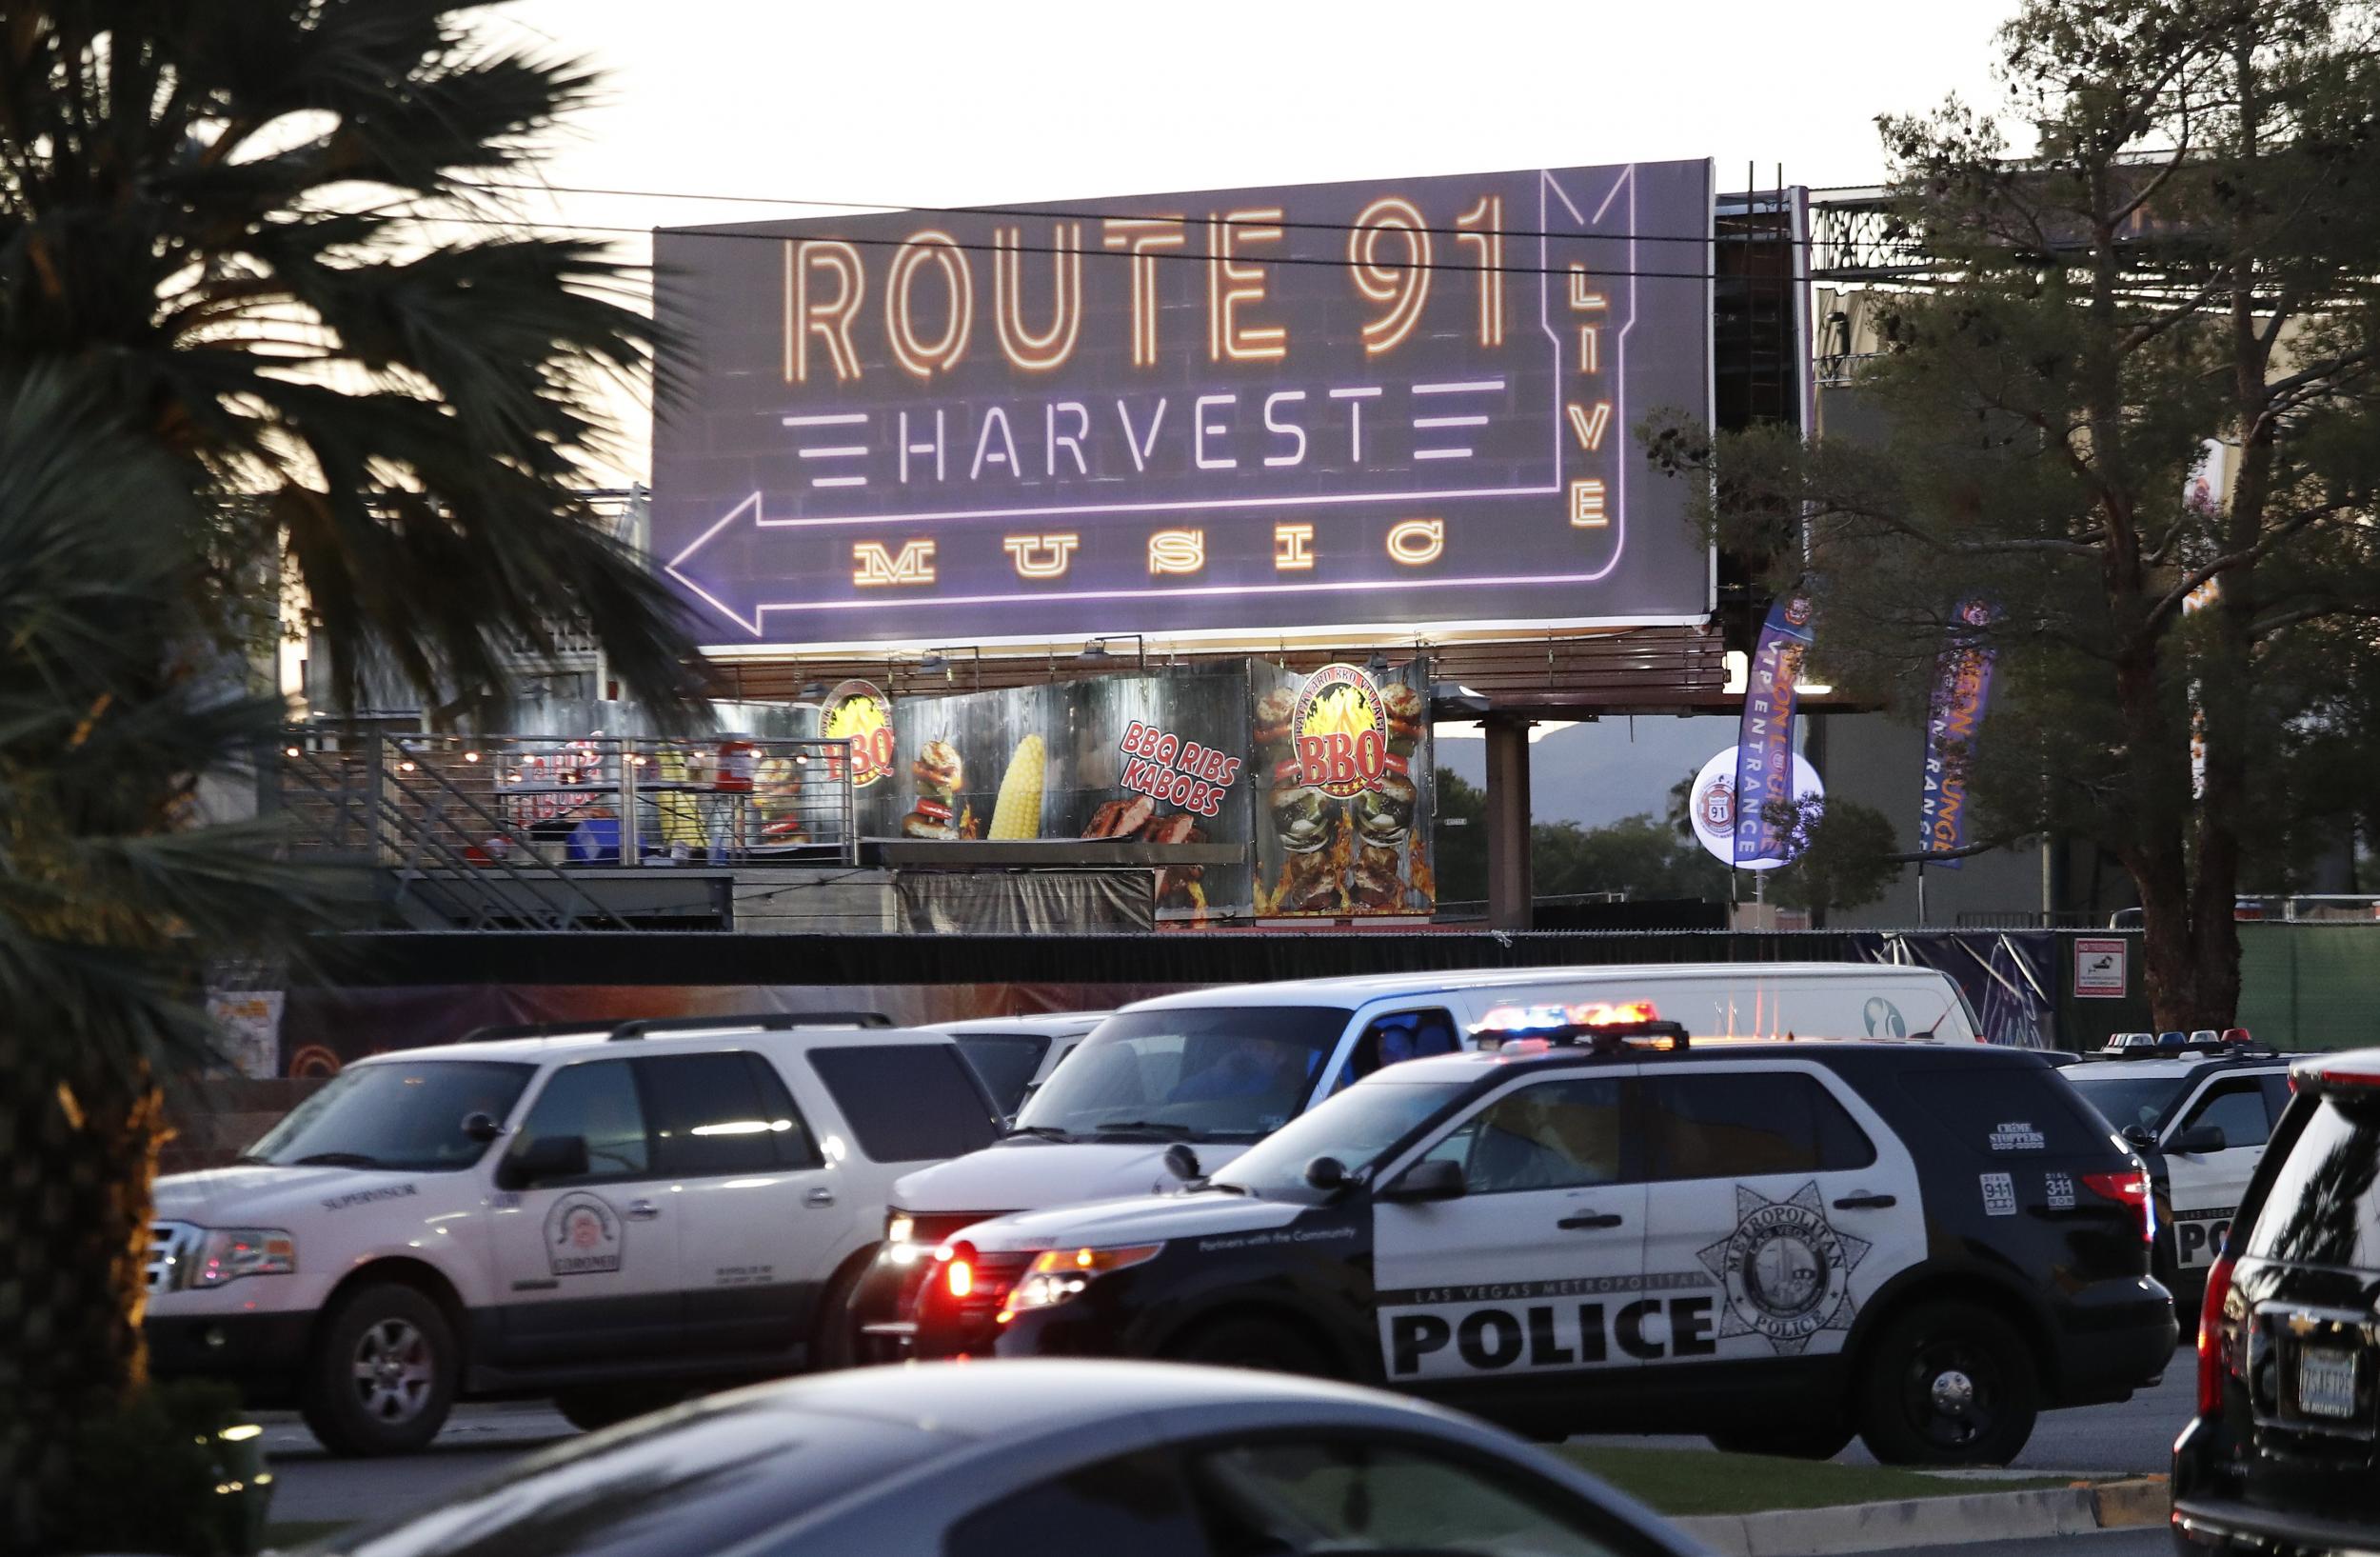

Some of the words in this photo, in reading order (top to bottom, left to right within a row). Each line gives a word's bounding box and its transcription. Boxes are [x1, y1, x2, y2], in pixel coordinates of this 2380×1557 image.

[784, 208, 1286, 382] ROUTE
[1348, 195, 1503, 357] 91
[1569, 262, 1612, 529] LIVE
[899, 388, 1383, 483] HARVEST
[853, 519, 1445, 586] MUSIC
[1760, 639, 1783, 686] VIP
[1121, 721, 1179, 768] BBQ
[1176, 741, 1241, 788] RIBS
[1296, 729, 1386, 793] BBQ
[1738, 699, 1769, 852] ENTRANCE
[1120, 757, 1226, 818] KABOBS
[1711, 806, 1725, 819] 91
[1989, 1132, 2044, 1143] STOPPERS
[322, 1183, 417, 1210] SUPERVISOR
[1247, 1235, 1271, 1246] with
[1273, 1232, 1291, 1243] the
[1293, 1227, 1358, 1242] Community
[1727, 1207, 1844, 1273] METROPOLITAN
[1749, 1230, 1772, 1255] LAS
[1775, 1225, 1820, 1253] VEGAS
[1415, 1288, 1452, 1304] LAS
[1462, 1284, 1532, 1301] VEGAS
[1541, 1272, 1708, 1294] METROPOLITAN
[1392, 1296, 1717, 1375] POLICE
[1755, 1310, 1826, 1335] POLICE
